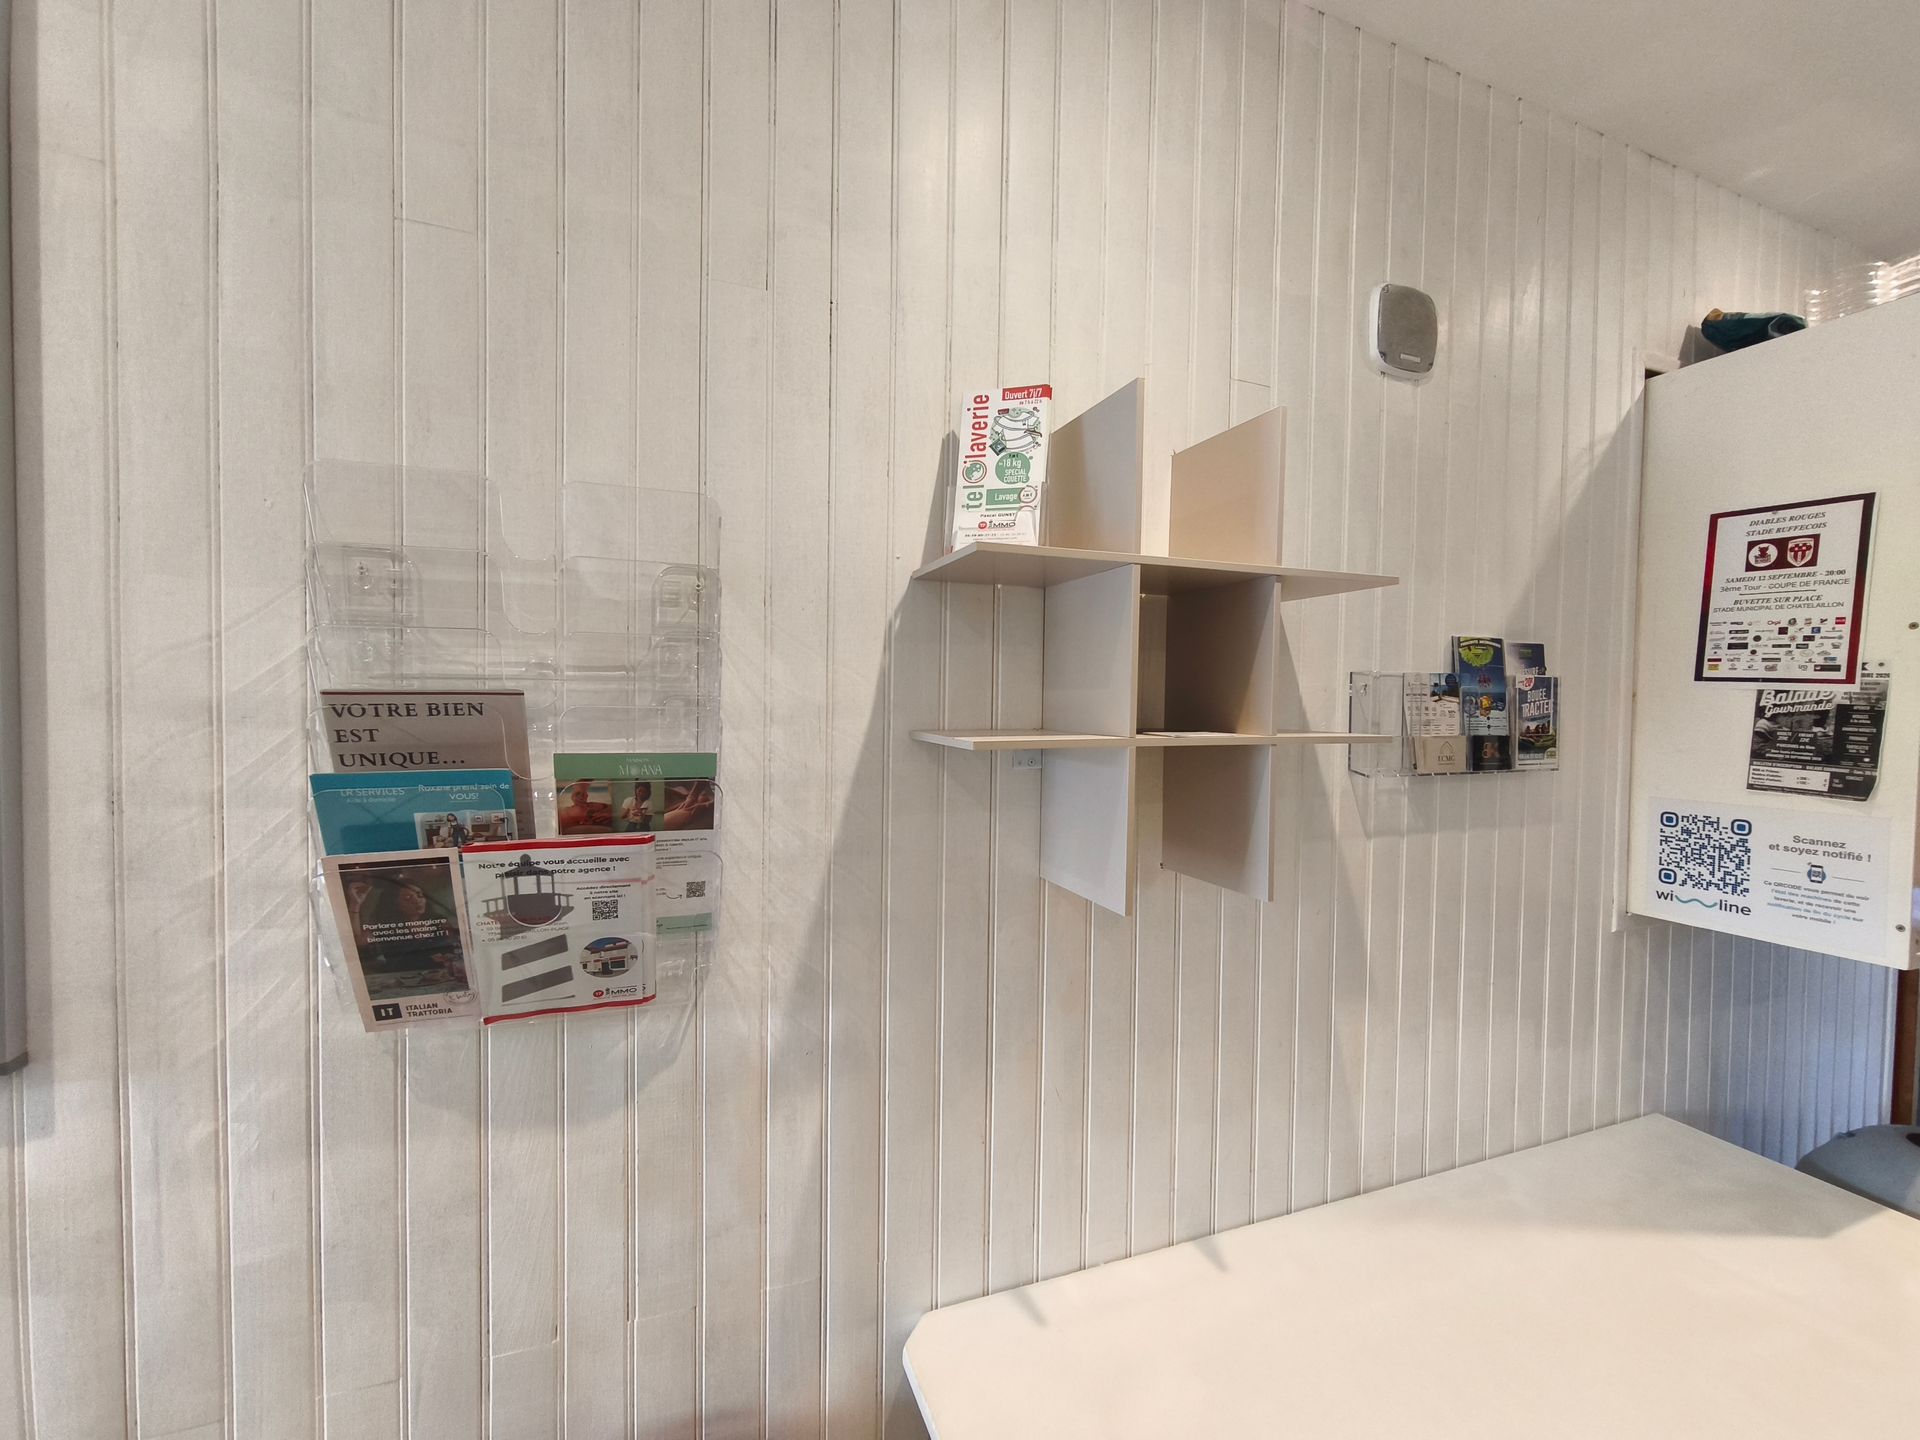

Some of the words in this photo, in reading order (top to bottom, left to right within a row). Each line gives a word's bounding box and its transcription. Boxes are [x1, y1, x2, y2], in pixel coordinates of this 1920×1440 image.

[1005, 391, 1028, 400] Ouvert
[1012, 458, 1022, 469] kg
[1004, 468, 1027, 476] SPECIAL
[1003, 475, 1028, 483] COUETTE
[994, 493, 1018, 502] Lavage
[1749, 516, 1787, 526] DIABLES
[1788, 511, 1827, 522] ROUGES
[1745, 527, 1774, 537] STADE
[1775, 521, 1828, 534] RUFFECOIS
[1767, 571, 1817, 581] SEPTEMBRE
[1824, 569, 1846, 577] 20:00
[1768, 581, 1797, 590] COUPE
[1812, 578, 1851, 586] FRANCE
[1733, 597, 1772, 606] BUVETTE
[1773, 596, 1791, 604] SUR
[1792, 594, 1823, 602] PLACE
[1736, 604, 1773, 612] MUNICIPAL
[1786, 601, 1844, 609] CHATELAILLON
[328, 703, 418, 718] VOTRE
[426, 702, 484, 717] BIEN
[1764, 700, 1834, 718] Gourmande
[334, 728, 379, 744] EST
[338, 751, 465, 768] UNIQUE...
[355, 787, 406, 797] SERVICES
[452, 783, 478, 793] prend
[499, 782, 510, 790] de
[1792, 835, 1847, 849] Scannez
[1768, 843, 1780, 851] et
[1783, 845, 1819, 856] soyez
[1822, 849, 1863, 862] notifié
[478, 862, 506, 870] Notre
[507, 860, 541, 870] équipe
[542, 858, 565, 866] vous
[566, 856, 607, 865] accueille
[551, 867, 576, 876] notre
[577, 866, 611, 875] agence
[1773, 881, 1802, 890] QRCODE
[363, 923, 396, 931] Parlare
[405, 918, 447, 927] mangiare
[367, 935, 413, 943] bienvenue
[380, 1007, 394, 1017] IT
[405, 1002, 439, 1011] ITALIAN
[407, 1007, 453, 1018] TRATTORIA
